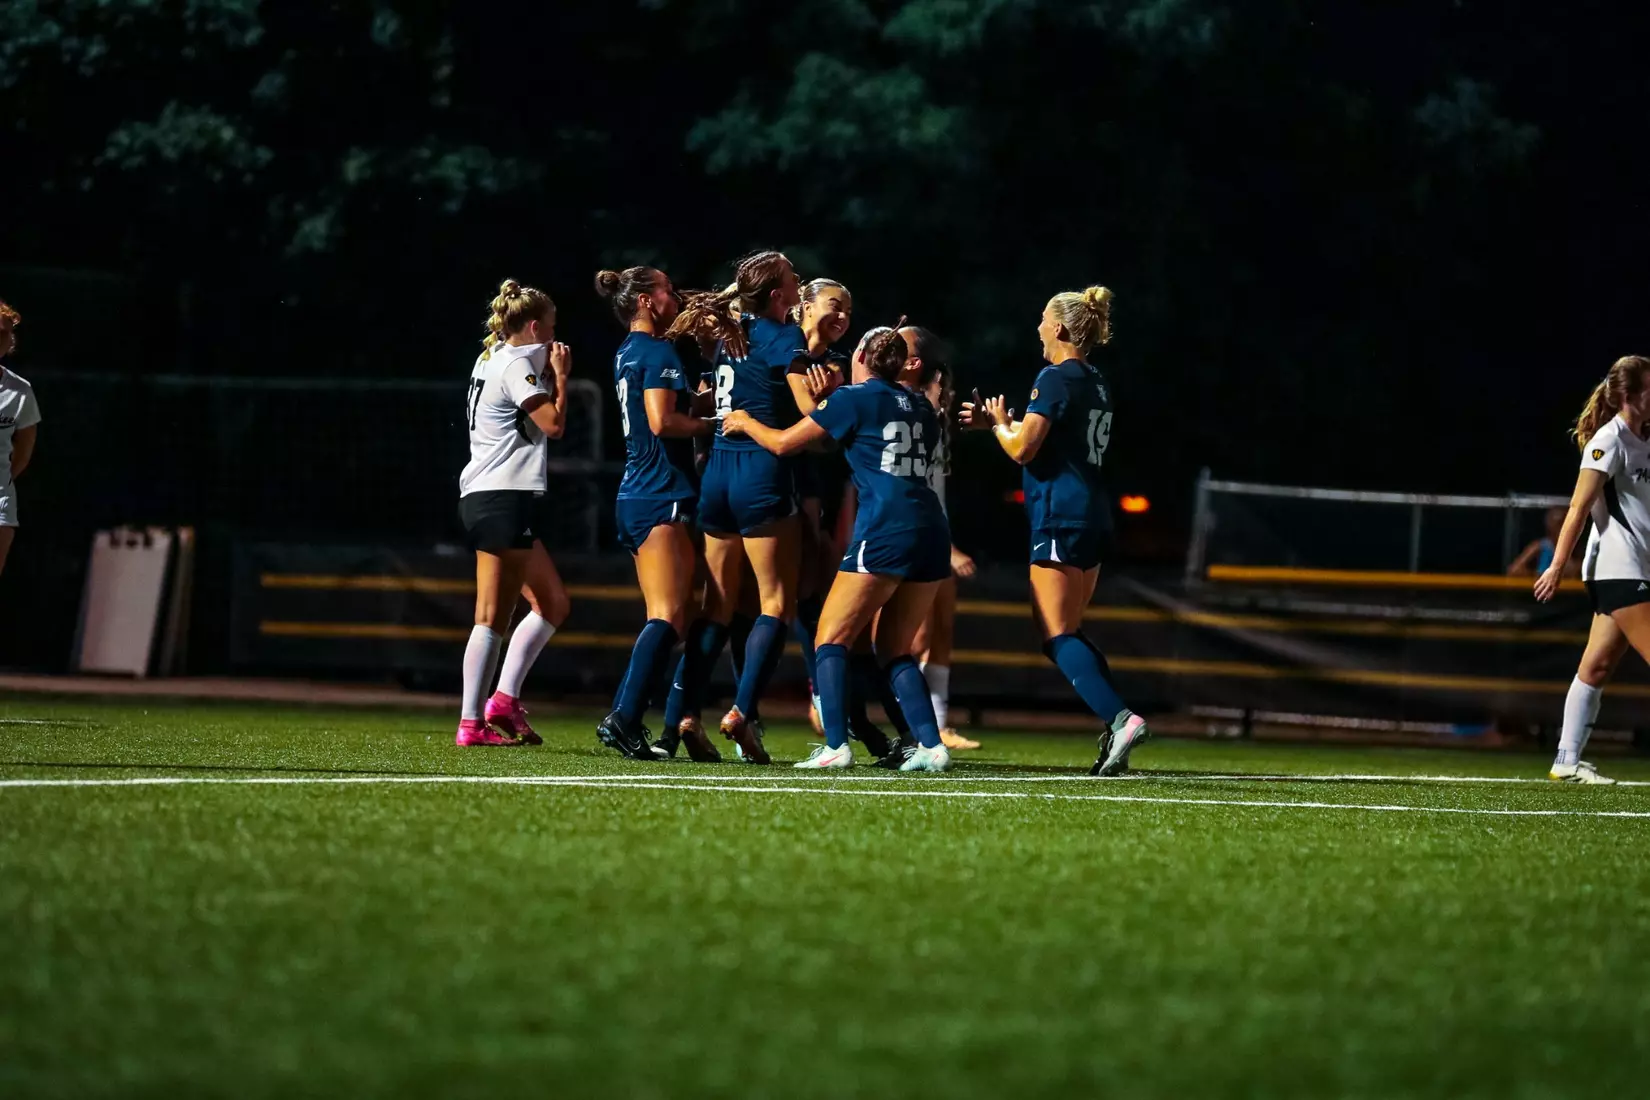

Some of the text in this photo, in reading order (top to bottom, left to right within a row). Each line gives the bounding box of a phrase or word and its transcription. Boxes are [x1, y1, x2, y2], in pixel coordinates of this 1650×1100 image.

[715, 364, 735, 417] 8
[880, 421, 927, 476] 23
[1087, 409, 1113, 466] 19
